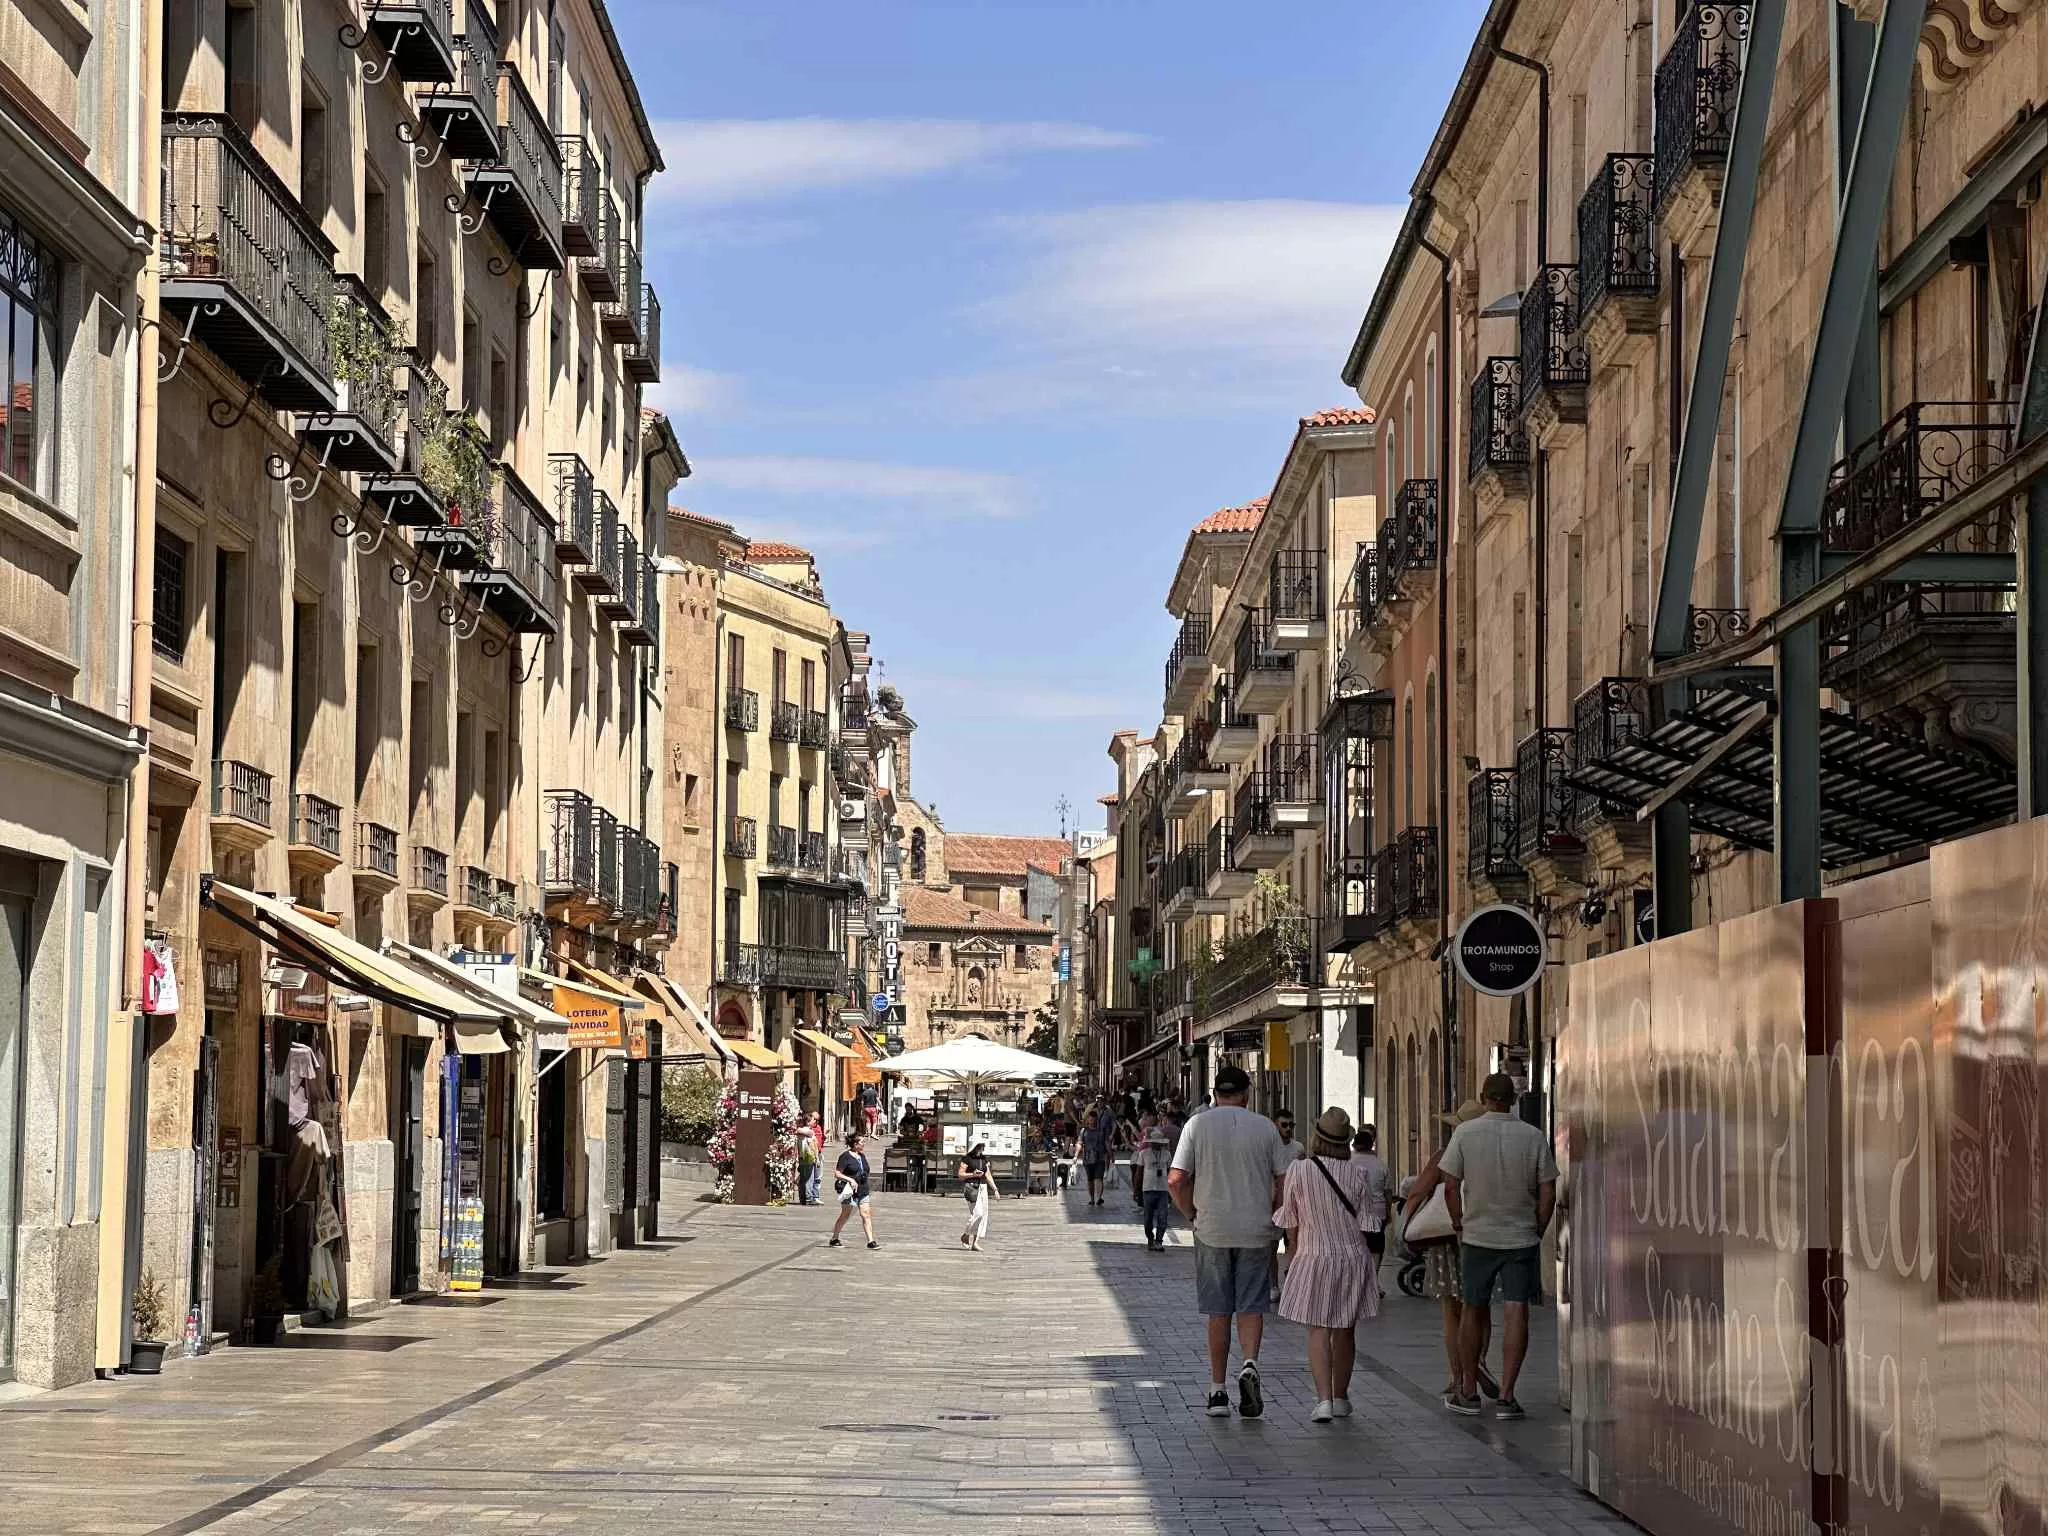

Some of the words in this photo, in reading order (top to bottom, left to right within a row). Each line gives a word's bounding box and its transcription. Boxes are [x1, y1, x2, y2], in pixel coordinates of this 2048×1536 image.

[885, 920, 898, 1004] HOTE
[1463, 945, 1540, 955] TROTAMUNDOS
[1489, 962, 1514, 972] Shop
[567, 1009, 608, 1018] LOTERIA
[1629, 994, 1937, 1283] Salamanca
[1645, 1244, 1766, 1449] Semana
